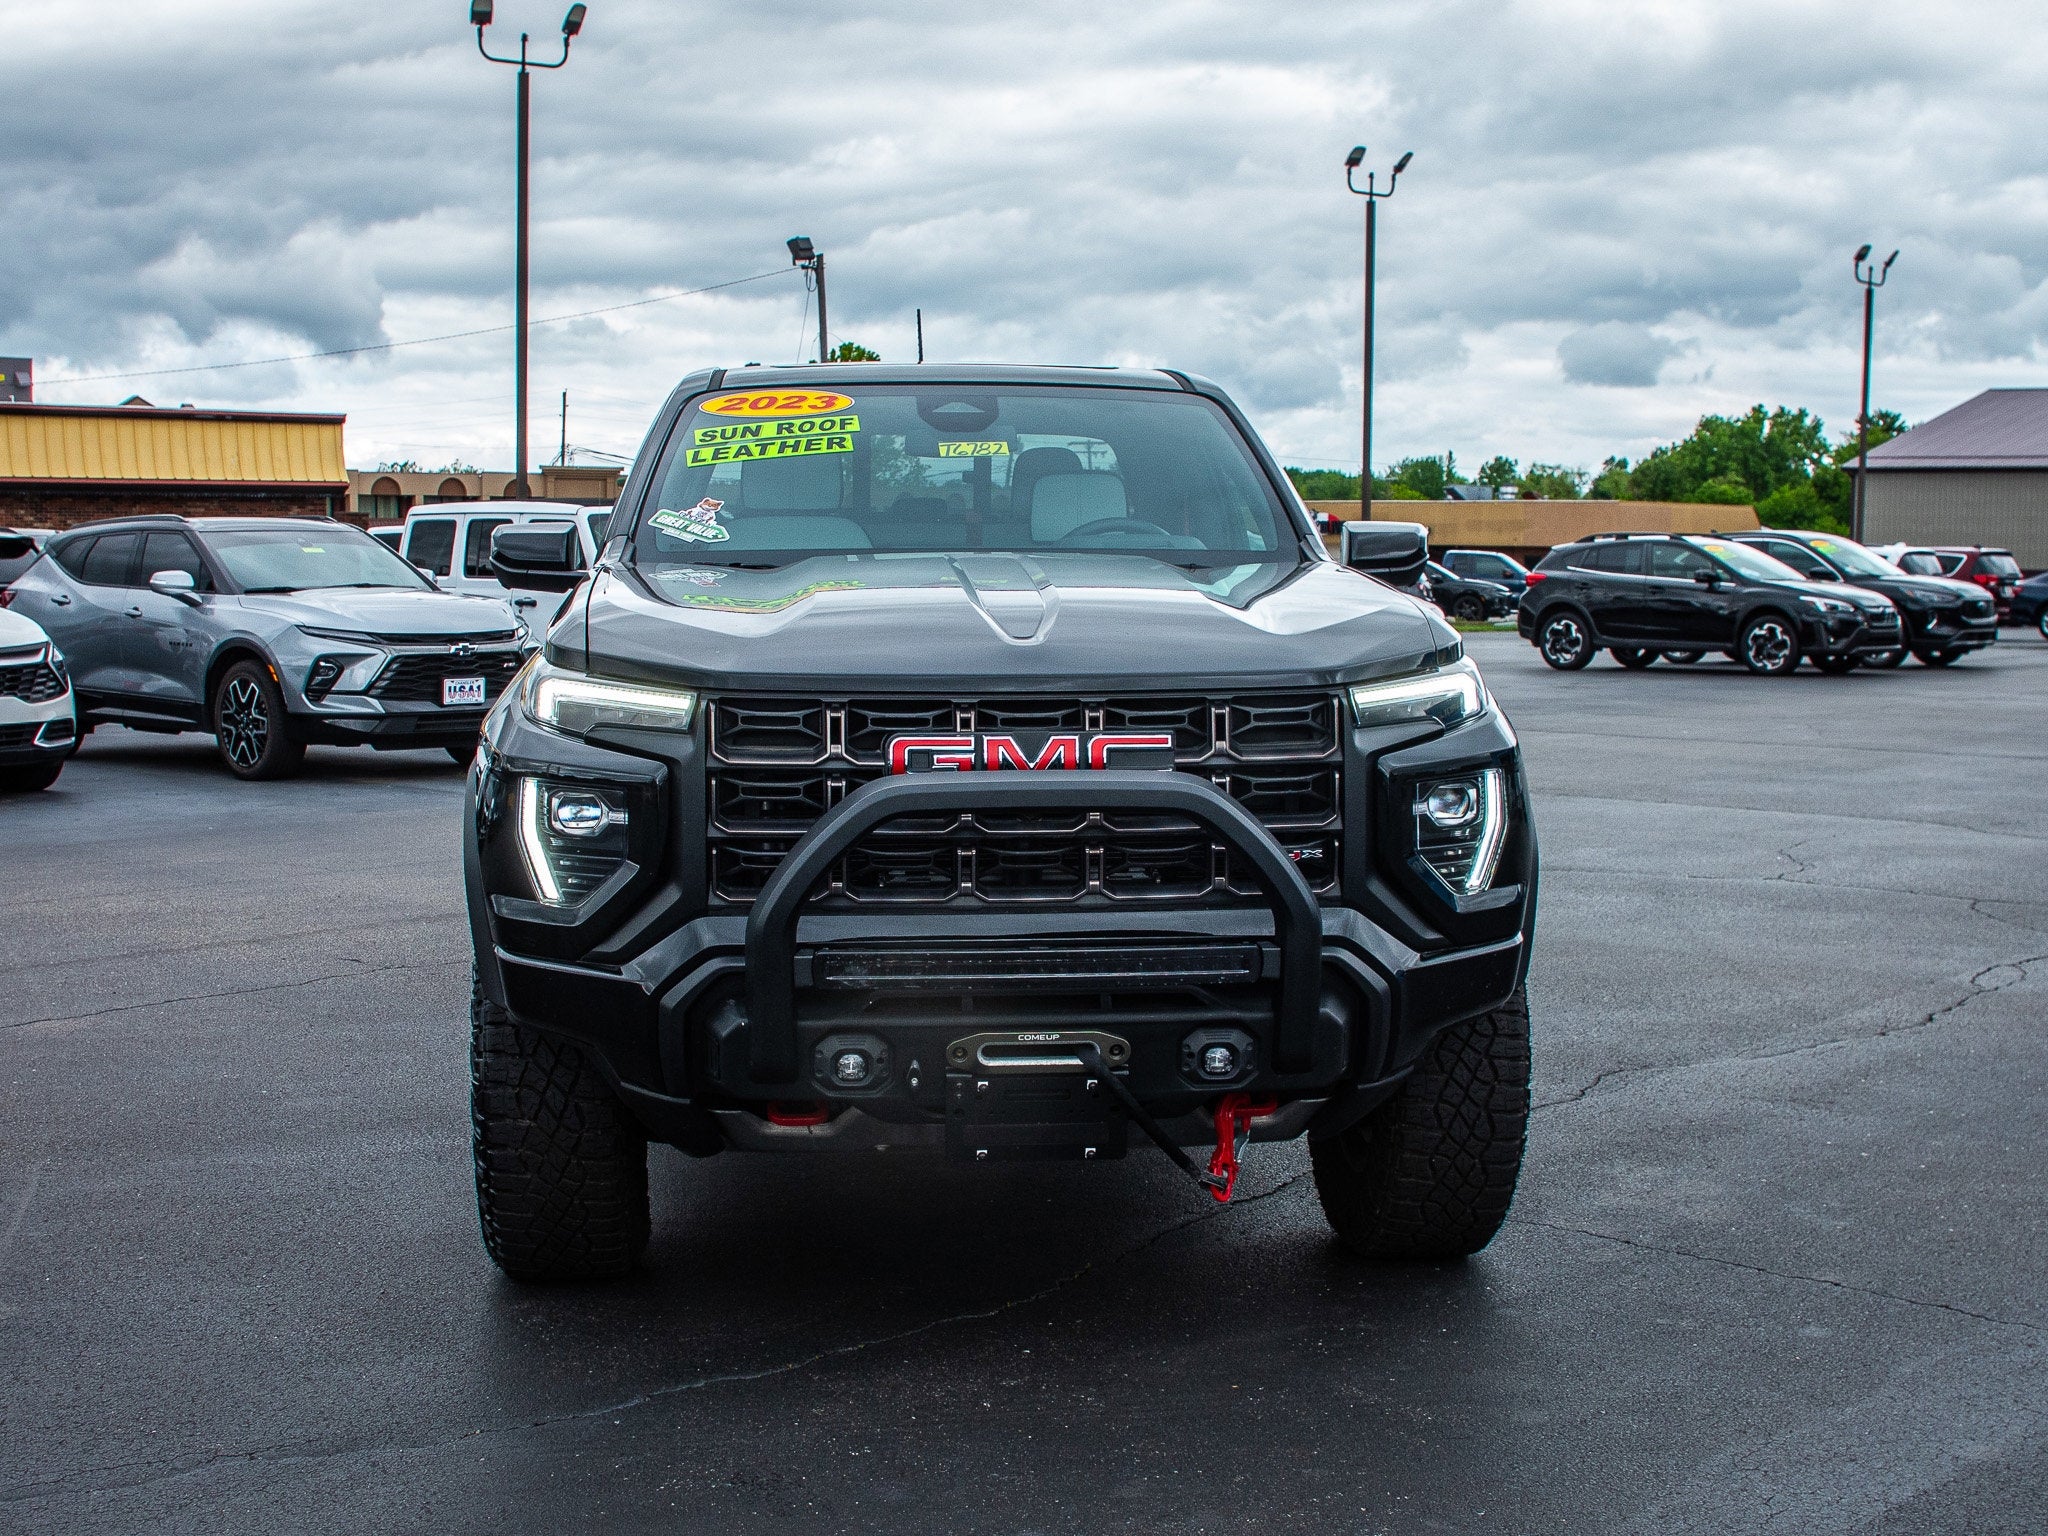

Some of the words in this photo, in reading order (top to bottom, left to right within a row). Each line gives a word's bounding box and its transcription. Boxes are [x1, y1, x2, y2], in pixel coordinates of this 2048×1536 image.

[716, 395, 839, 412] 2023
[699, 424, 764, 442] SUN
[776, 417, 854, 435] ROOF
[691, 436, 848, 464] LEATHER
[656, 514, 690, 529] GREAT
[686, 522, 719, 539] VALUE
[889, 735, 1172, 774] GMC
